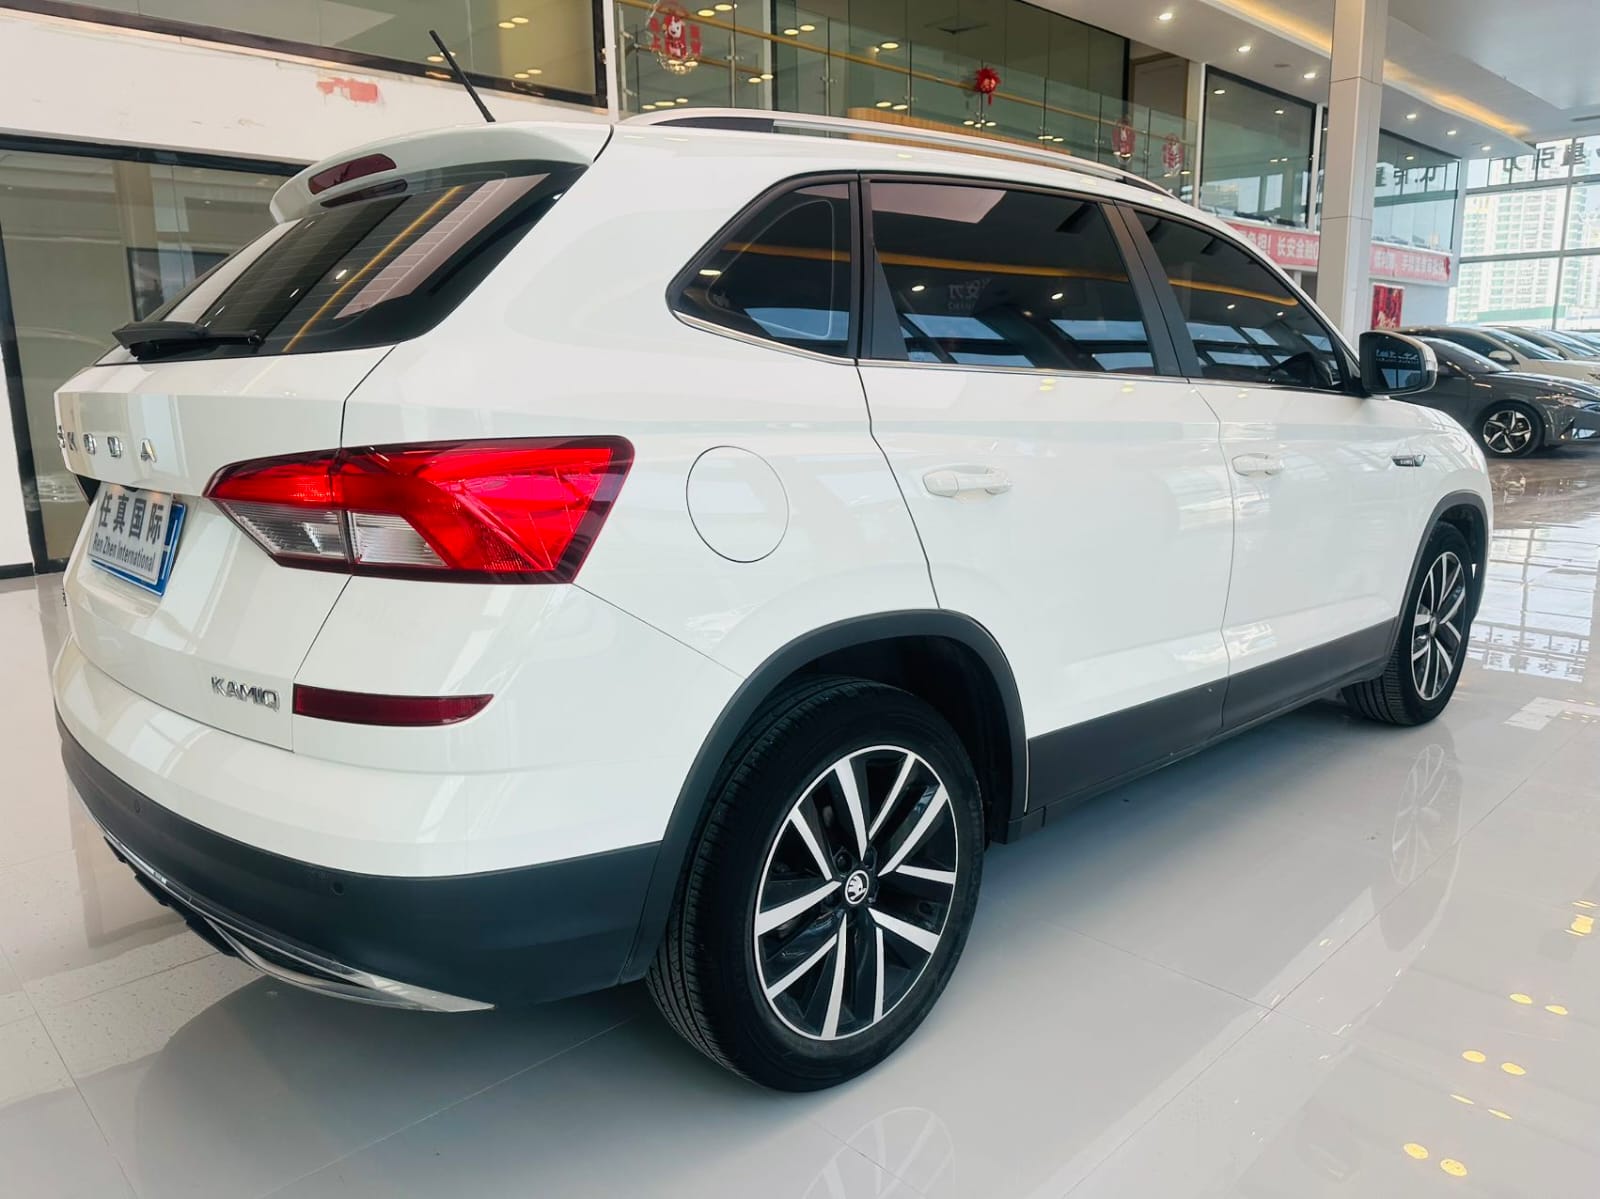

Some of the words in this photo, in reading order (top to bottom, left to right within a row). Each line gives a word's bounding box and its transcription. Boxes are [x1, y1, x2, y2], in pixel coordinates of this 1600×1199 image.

[98, 490, 164, 545] 任真国际
[92, 532, 103, 552] Ren
[102, 535, 117, 558] Zhen
[116, 541, 156, 573] International
[211, 676, 280, 712] KAMIQ
